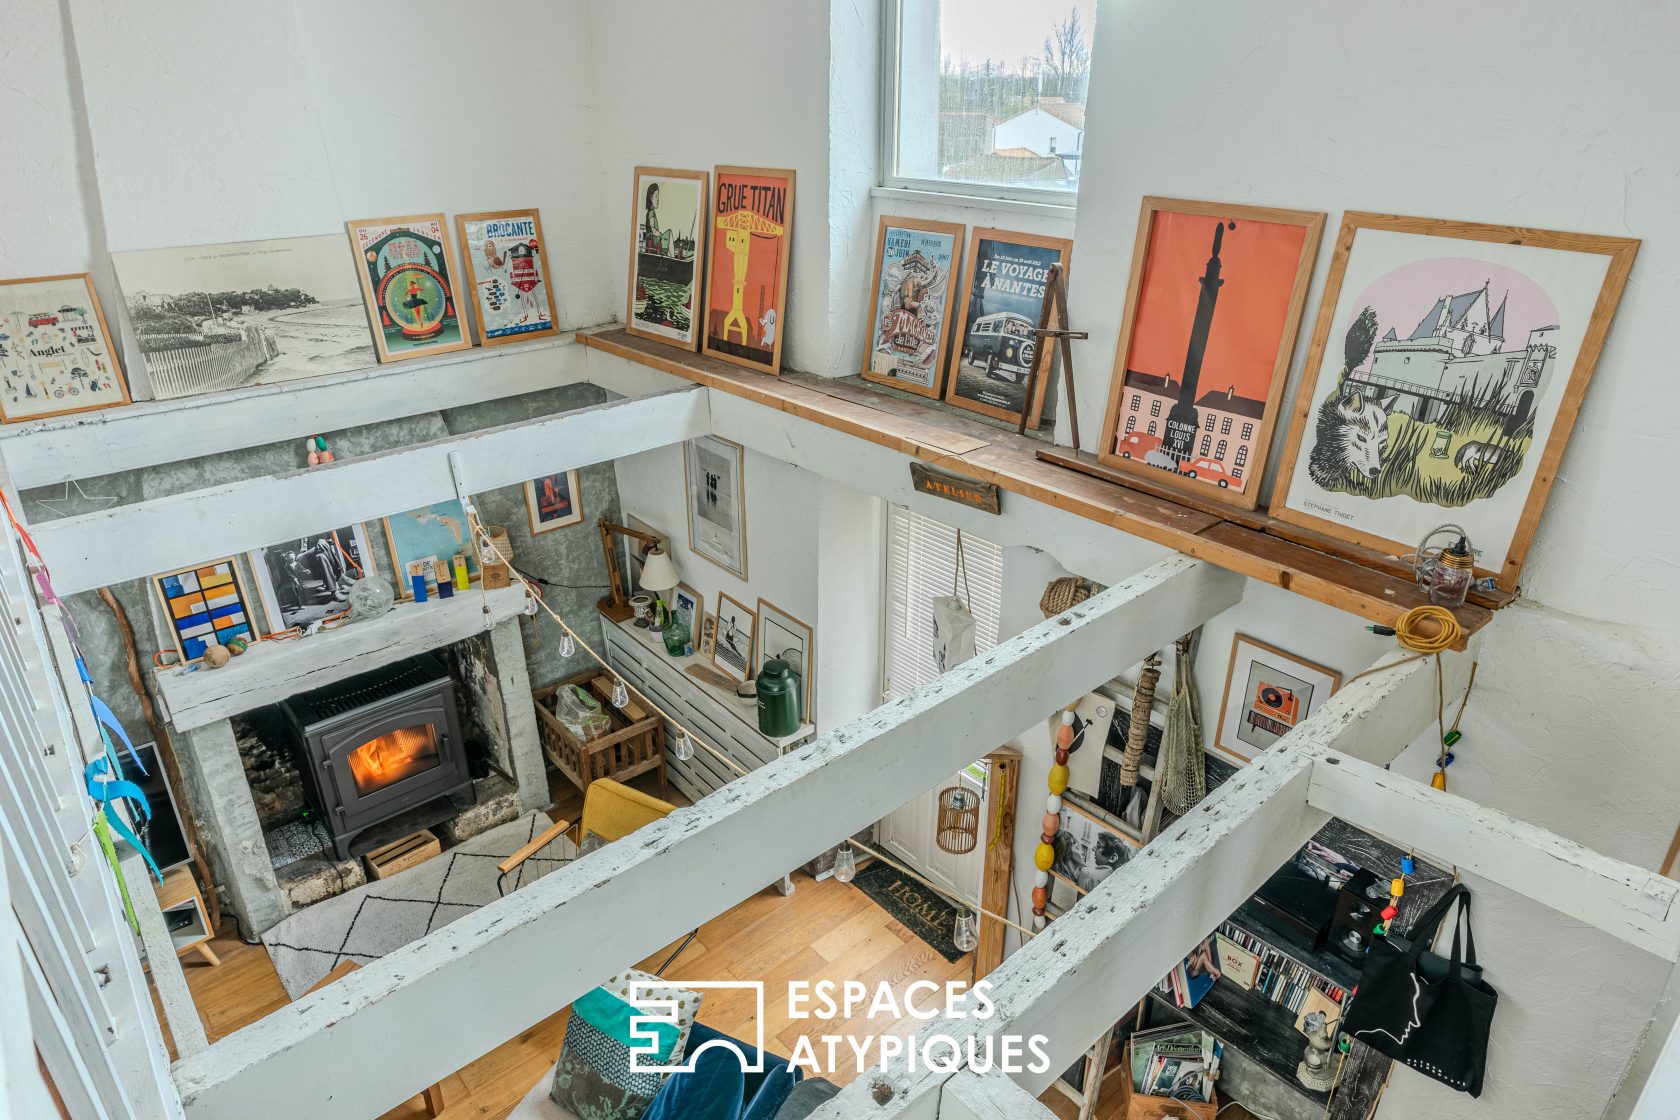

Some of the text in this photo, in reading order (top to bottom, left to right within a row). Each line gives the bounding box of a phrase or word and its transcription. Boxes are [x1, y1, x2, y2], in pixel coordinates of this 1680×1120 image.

[718, 182, 787, 224] GRUE TITAN
[486, 221, 534, 238] BROCANTE
[887, 237, 911, 248] SAMEDI
[981, 259, 1049, 282] LE VOYAGE
[992, 277, 1046, 298] NANTES
[30, 346, 65, 357] Anglet
[1168, 420, 1195, 433] COLONNE
[1170, 430, 1190, 441] LOUIS
[1173, 439, 1184, 449] XVI
[926, 480, 982, 503] ATELIER
